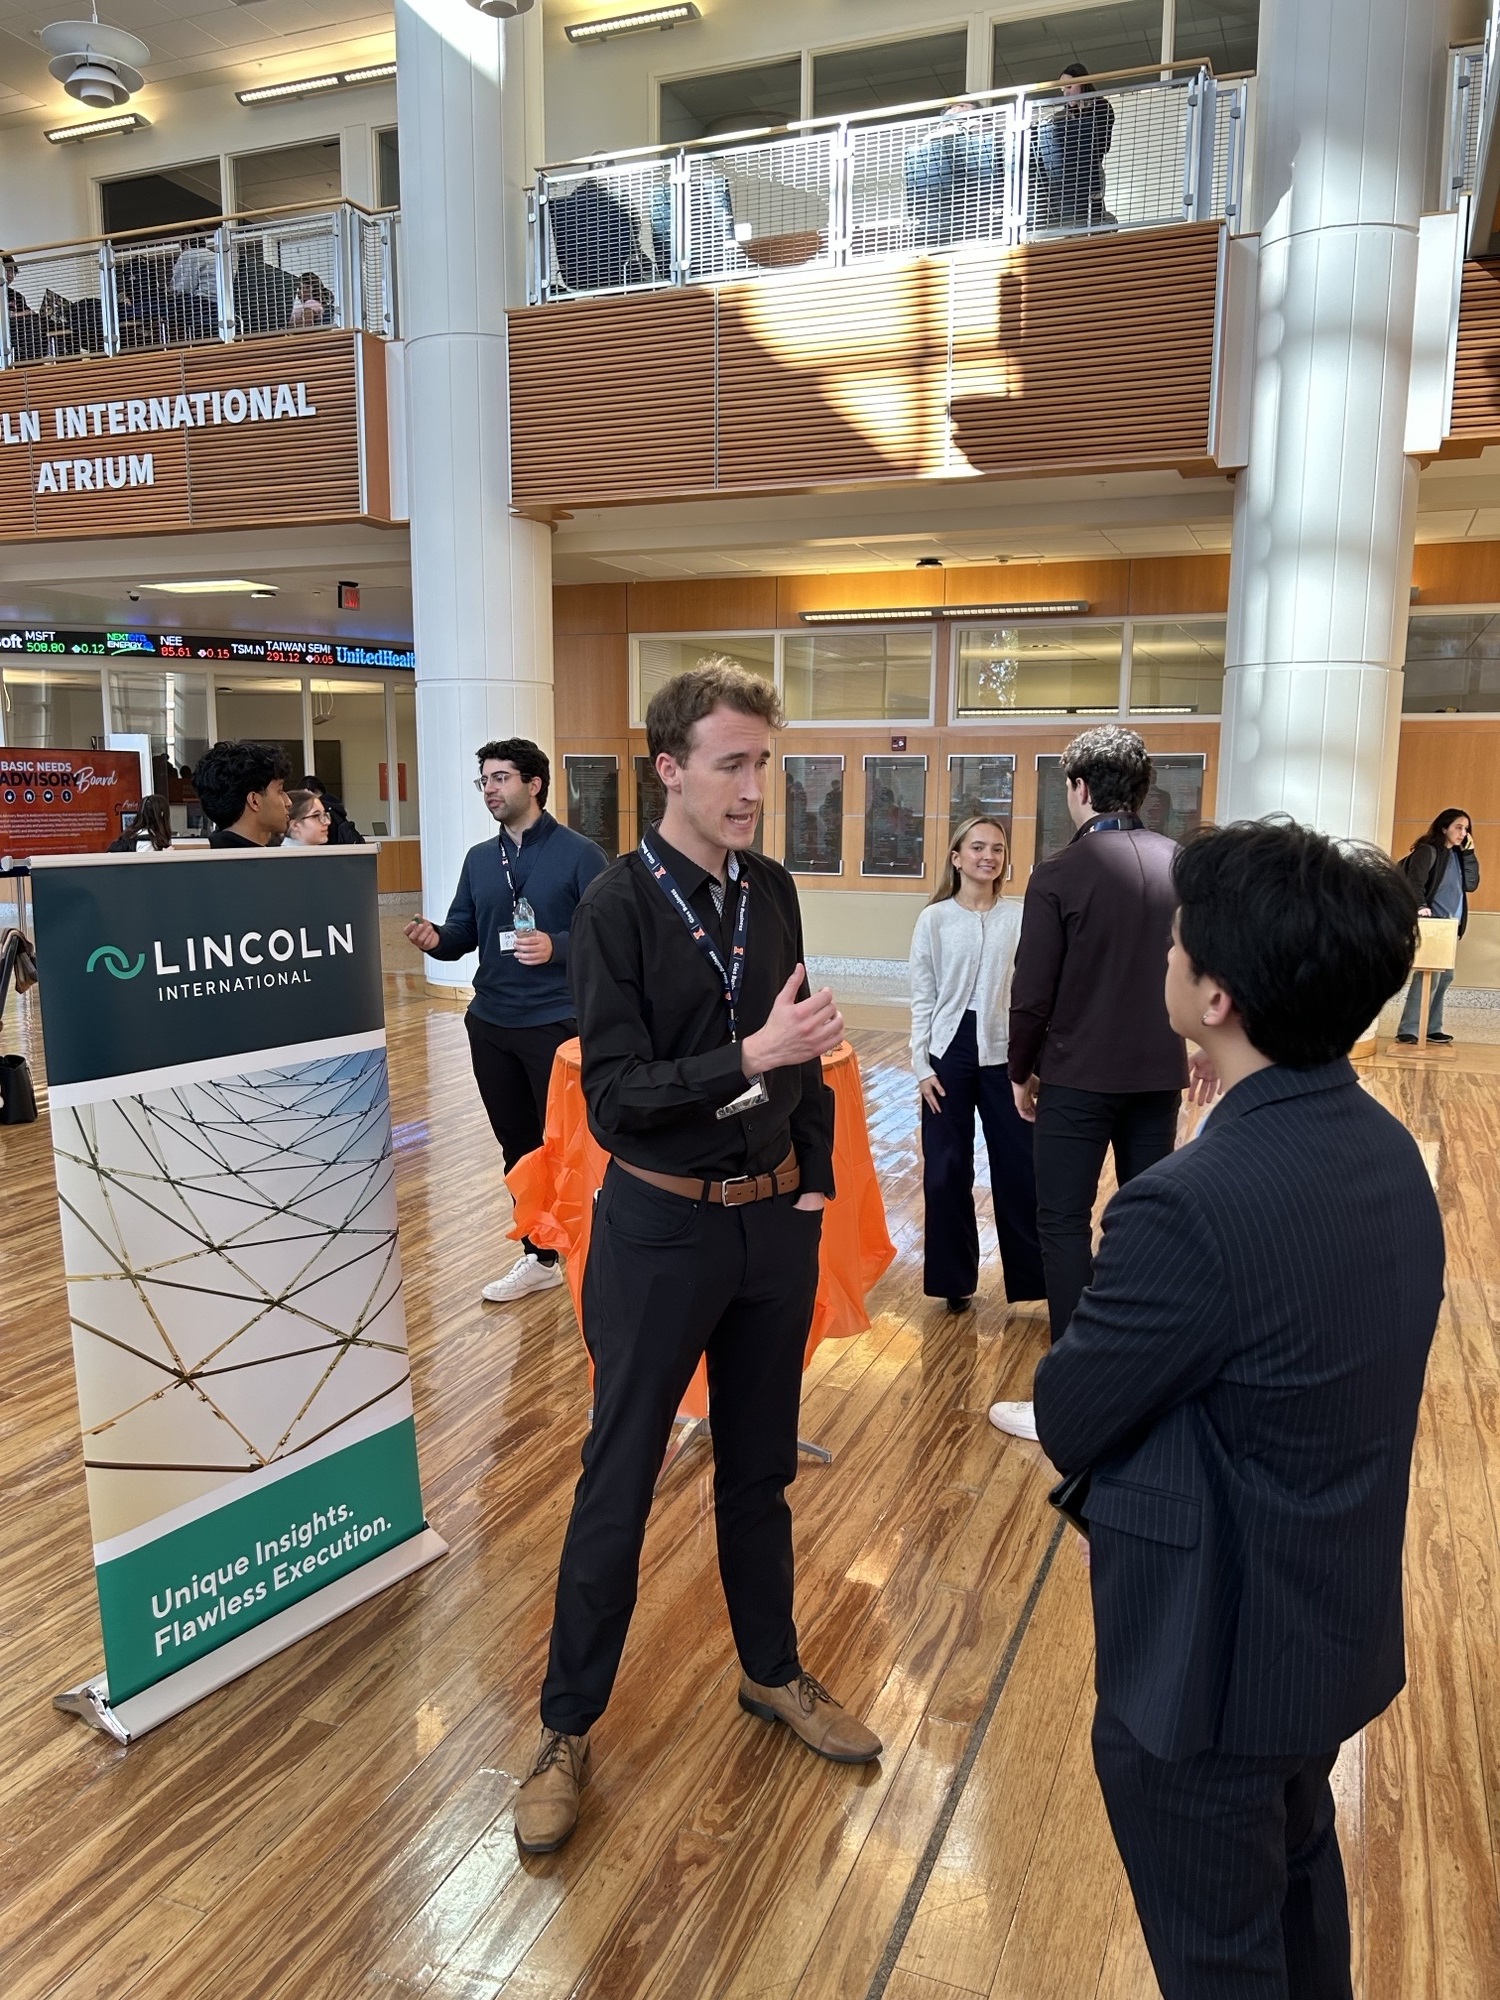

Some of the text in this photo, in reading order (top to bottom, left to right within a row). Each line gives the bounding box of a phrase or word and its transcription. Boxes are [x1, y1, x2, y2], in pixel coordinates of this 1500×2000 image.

[0, 382, 317, 444] LN INTERNATIONAL
[37, 453, 155, 494] ATRIUM
[0, 633, 23, 649] oft
[25, 630, 56, 641] MSFT
[160, 635, 183, 646] NEE
[26, 642, 105, 654] 508.80 0.12
[106, 640, 142, 650] ENERGY
[161, 646, 230, 659] 85.61 0.15
[231, 643, 264, 656] TSM.N
[265, 640, 331, 655] TAIWAN SEMI
[266, 652, 335, 664] 291.12 0.05
[0, 761, 72, 772] BASIC NEEDS
[73, 766, 118, 795] Board
[670, 888, 688, 912] Business
[154, 923, 354, 975] LINCOLN
[158, 969, 312, 1002] INTERNATIONAL
[150, 1502, 354, 1619] Unique Insights.
[154, 1514, 392, 1657] Flawless Execution.
